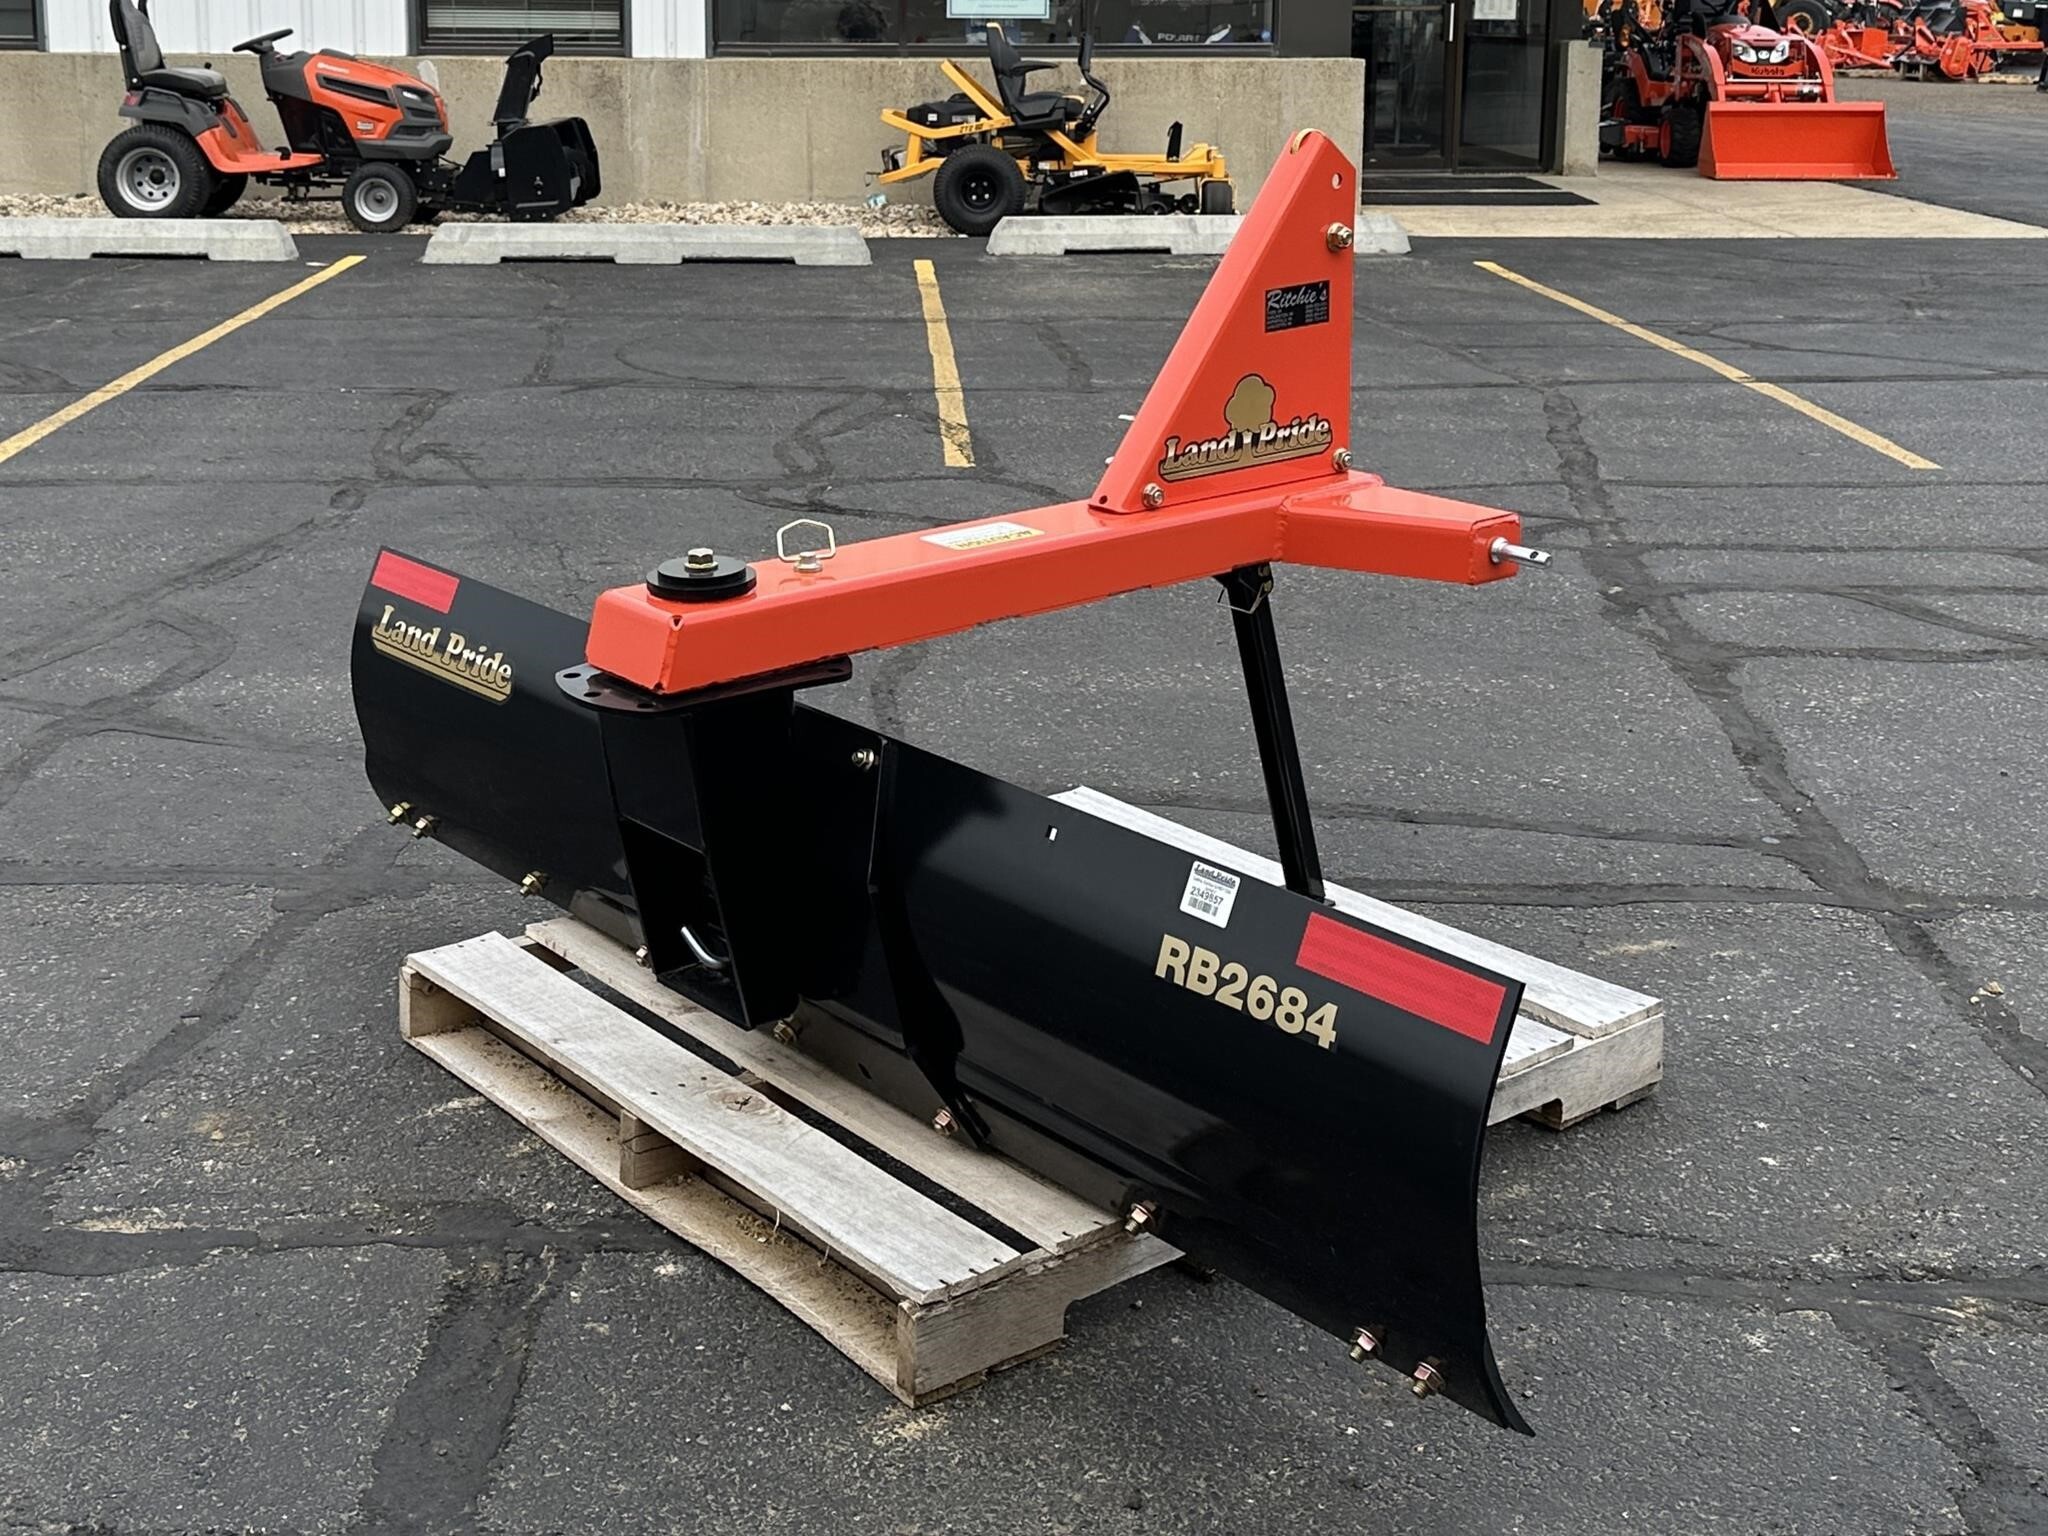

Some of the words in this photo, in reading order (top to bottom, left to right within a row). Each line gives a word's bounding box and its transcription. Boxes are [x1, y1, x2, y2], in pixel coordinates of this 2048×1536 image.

[1751, 66, 1785, 76] Kubota
[1267, 283, 1328, 312] Ritchie's
[1163, 429, 1241, 470] Land
[1255, 413, 1330, 454] Pride
[375, 604, 441, 658] Land
[441, 632, 512, 689] Pride
[1154, 933, 1339, 1050] RB2684
